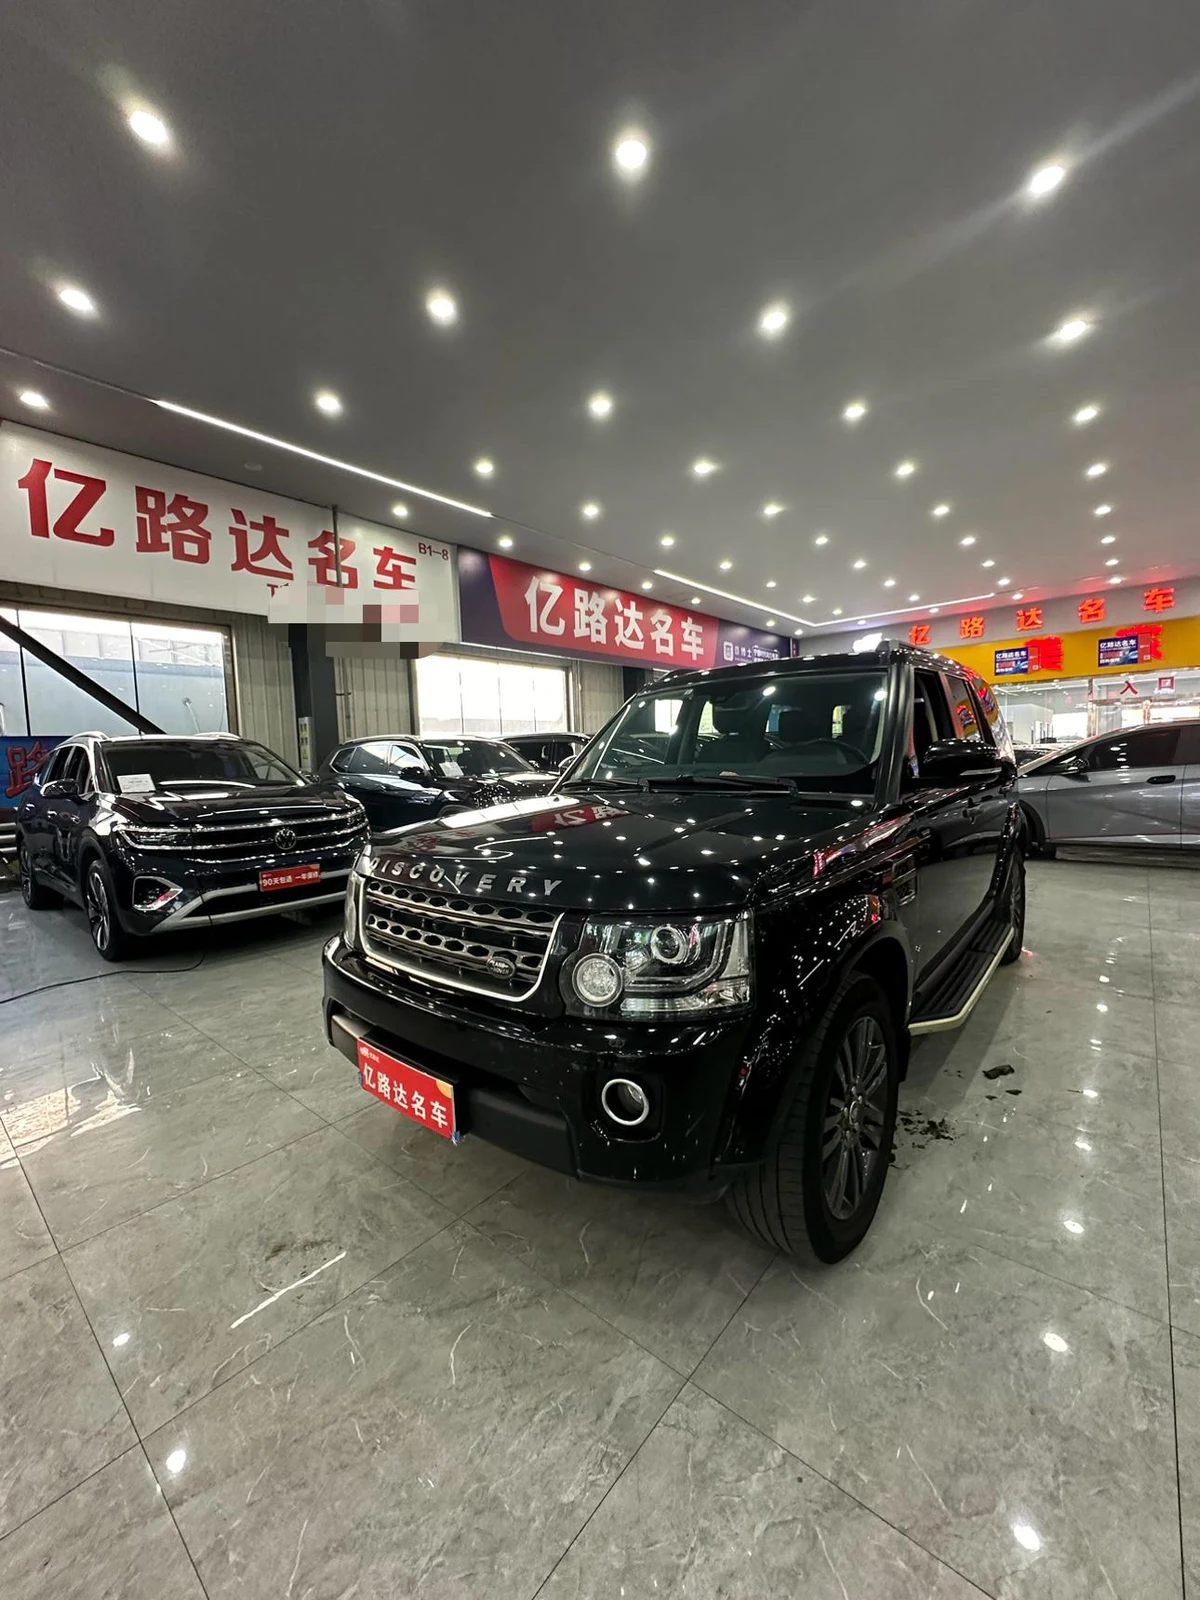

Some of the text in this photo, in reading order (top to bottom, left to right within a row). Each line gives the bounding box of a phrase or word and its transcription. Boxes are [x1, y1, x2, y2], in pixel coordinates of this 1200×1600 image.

[18, 458, 416, 590] 亿路达名车
[524, 575, 704, 661] 亿路达名车
[909, 586, 1175, 646] 亿路达名车
[1119, 676, 1175, 695] 入口
[370, 856, 562, 896] DISCOVERY
[363, 1062, 449, 1129] 亿路达名车
